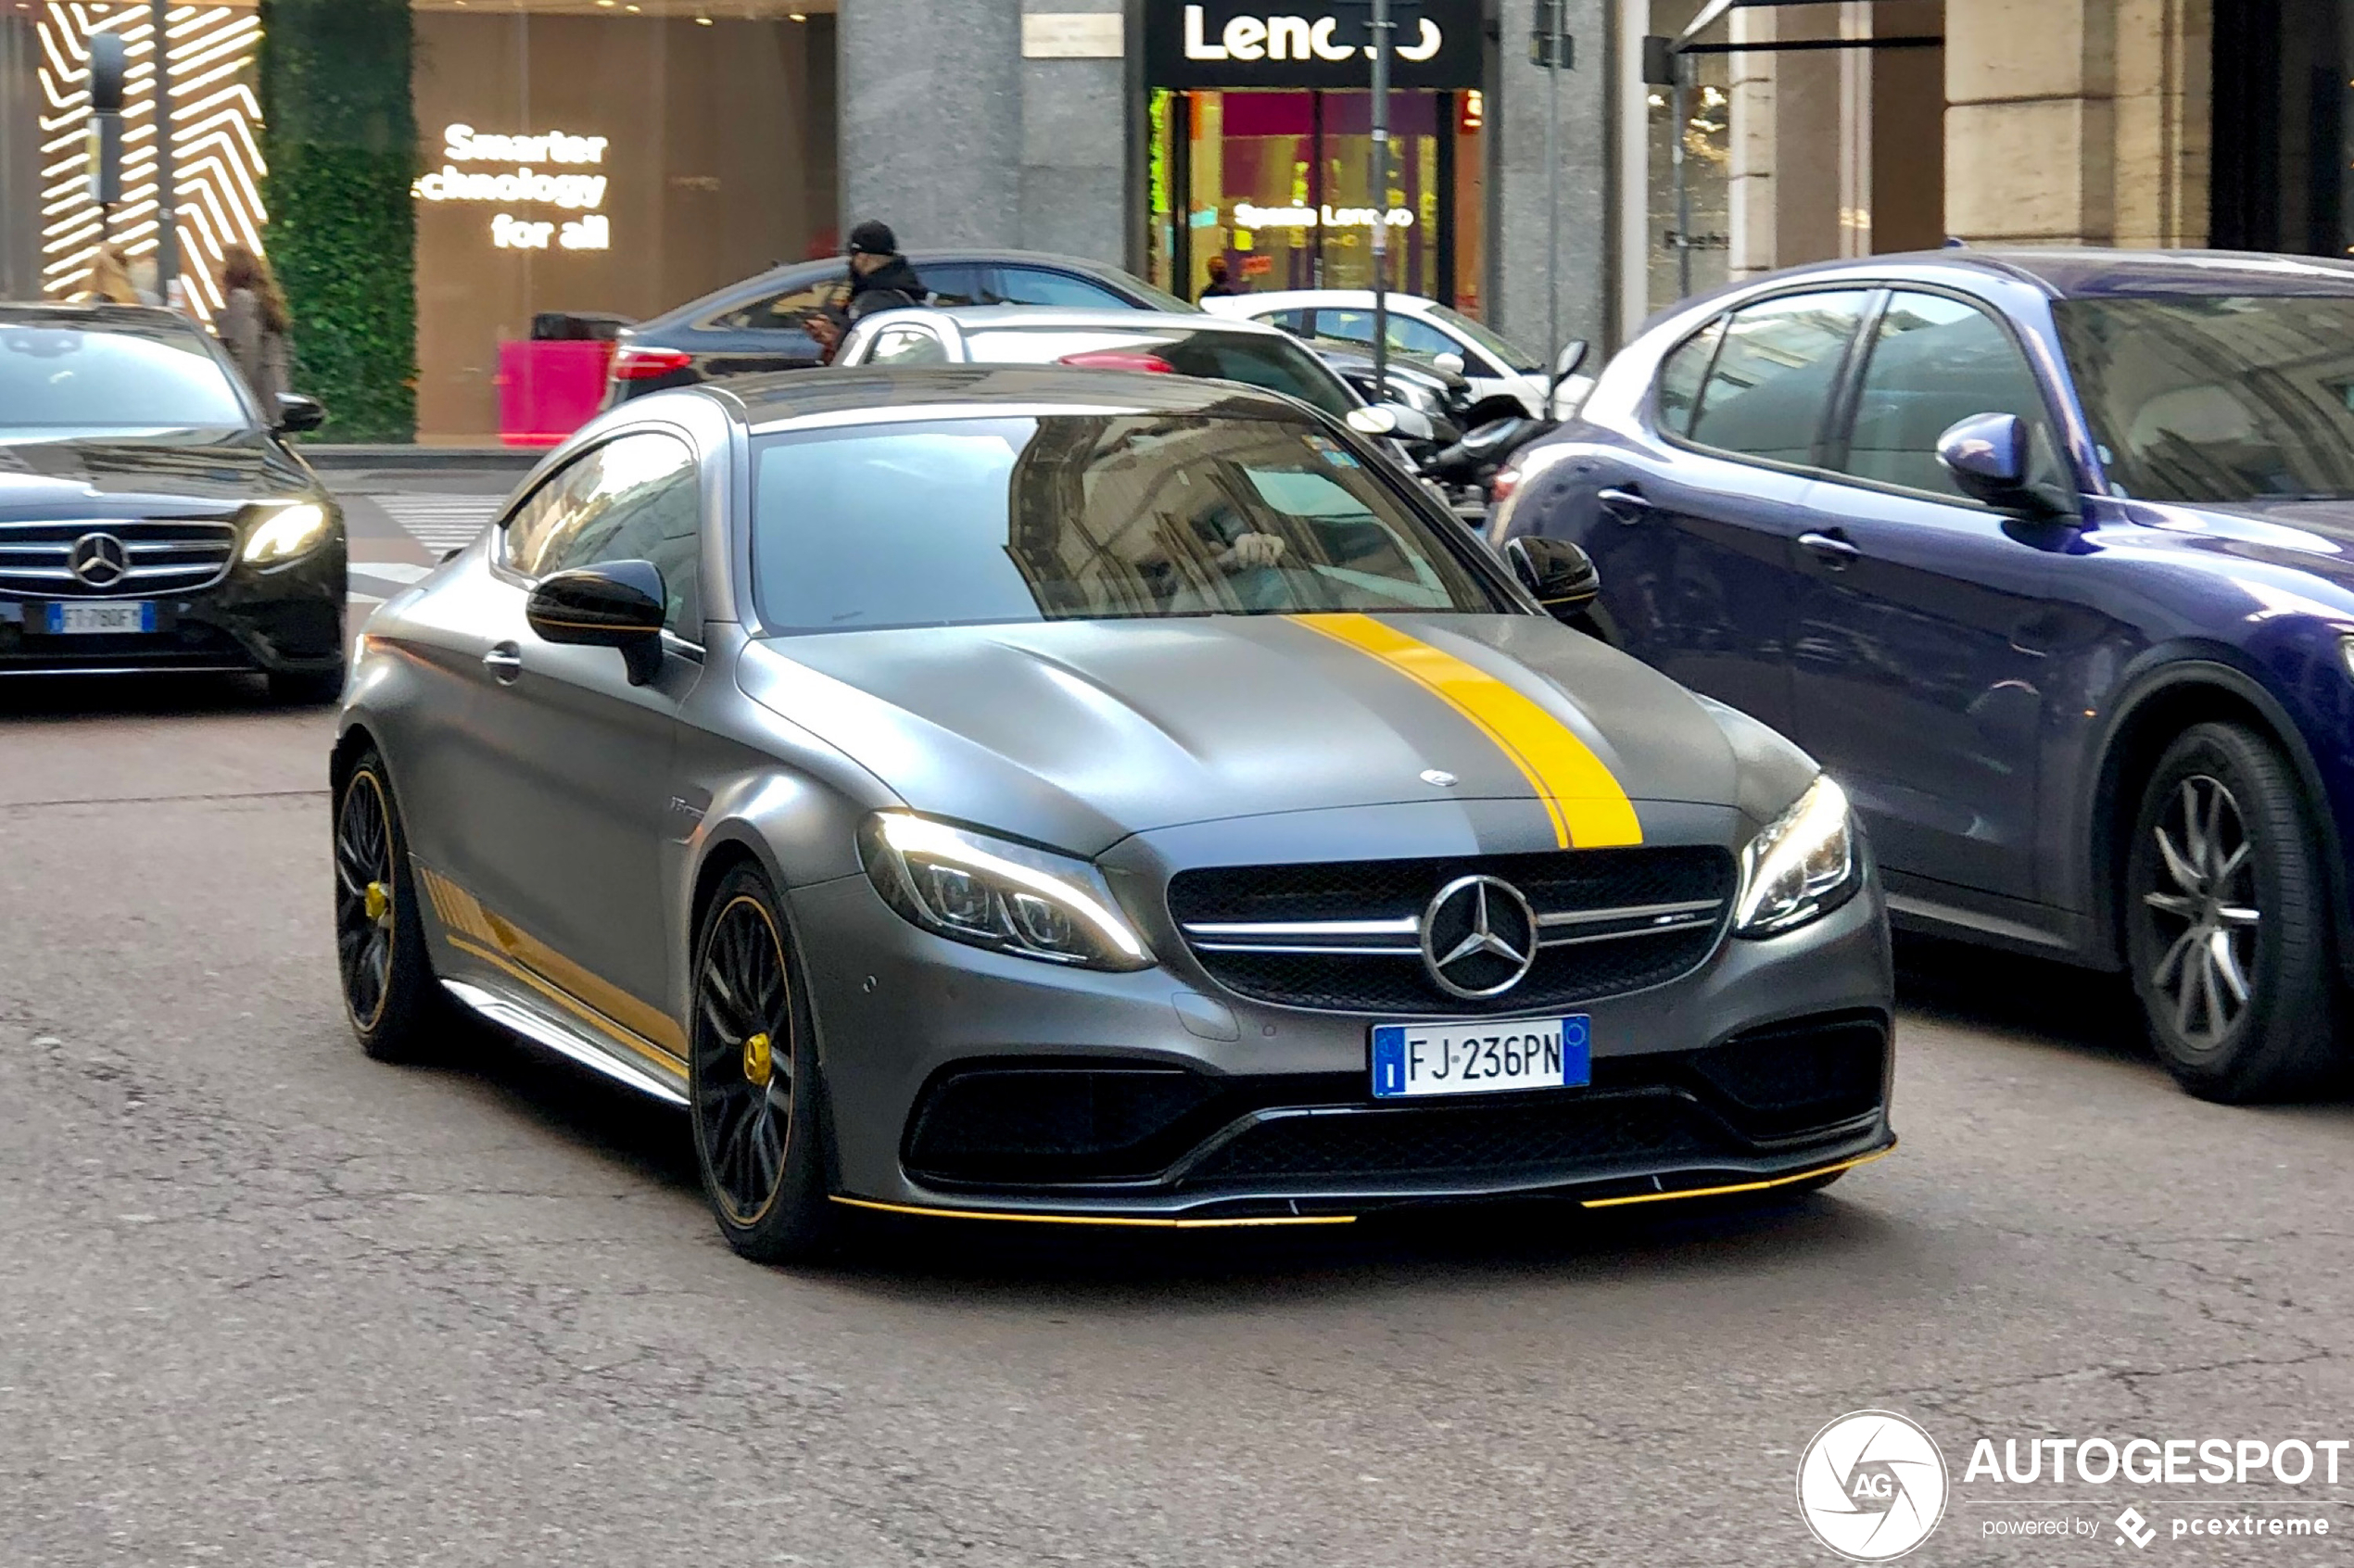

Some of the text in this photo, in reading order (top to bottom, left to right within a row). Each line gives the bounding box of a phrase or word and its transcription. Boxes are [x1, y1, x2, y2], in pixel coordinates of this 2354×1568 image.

[444, 124, 608, 163] Smarter
[490, 213, 609, 249] for all
